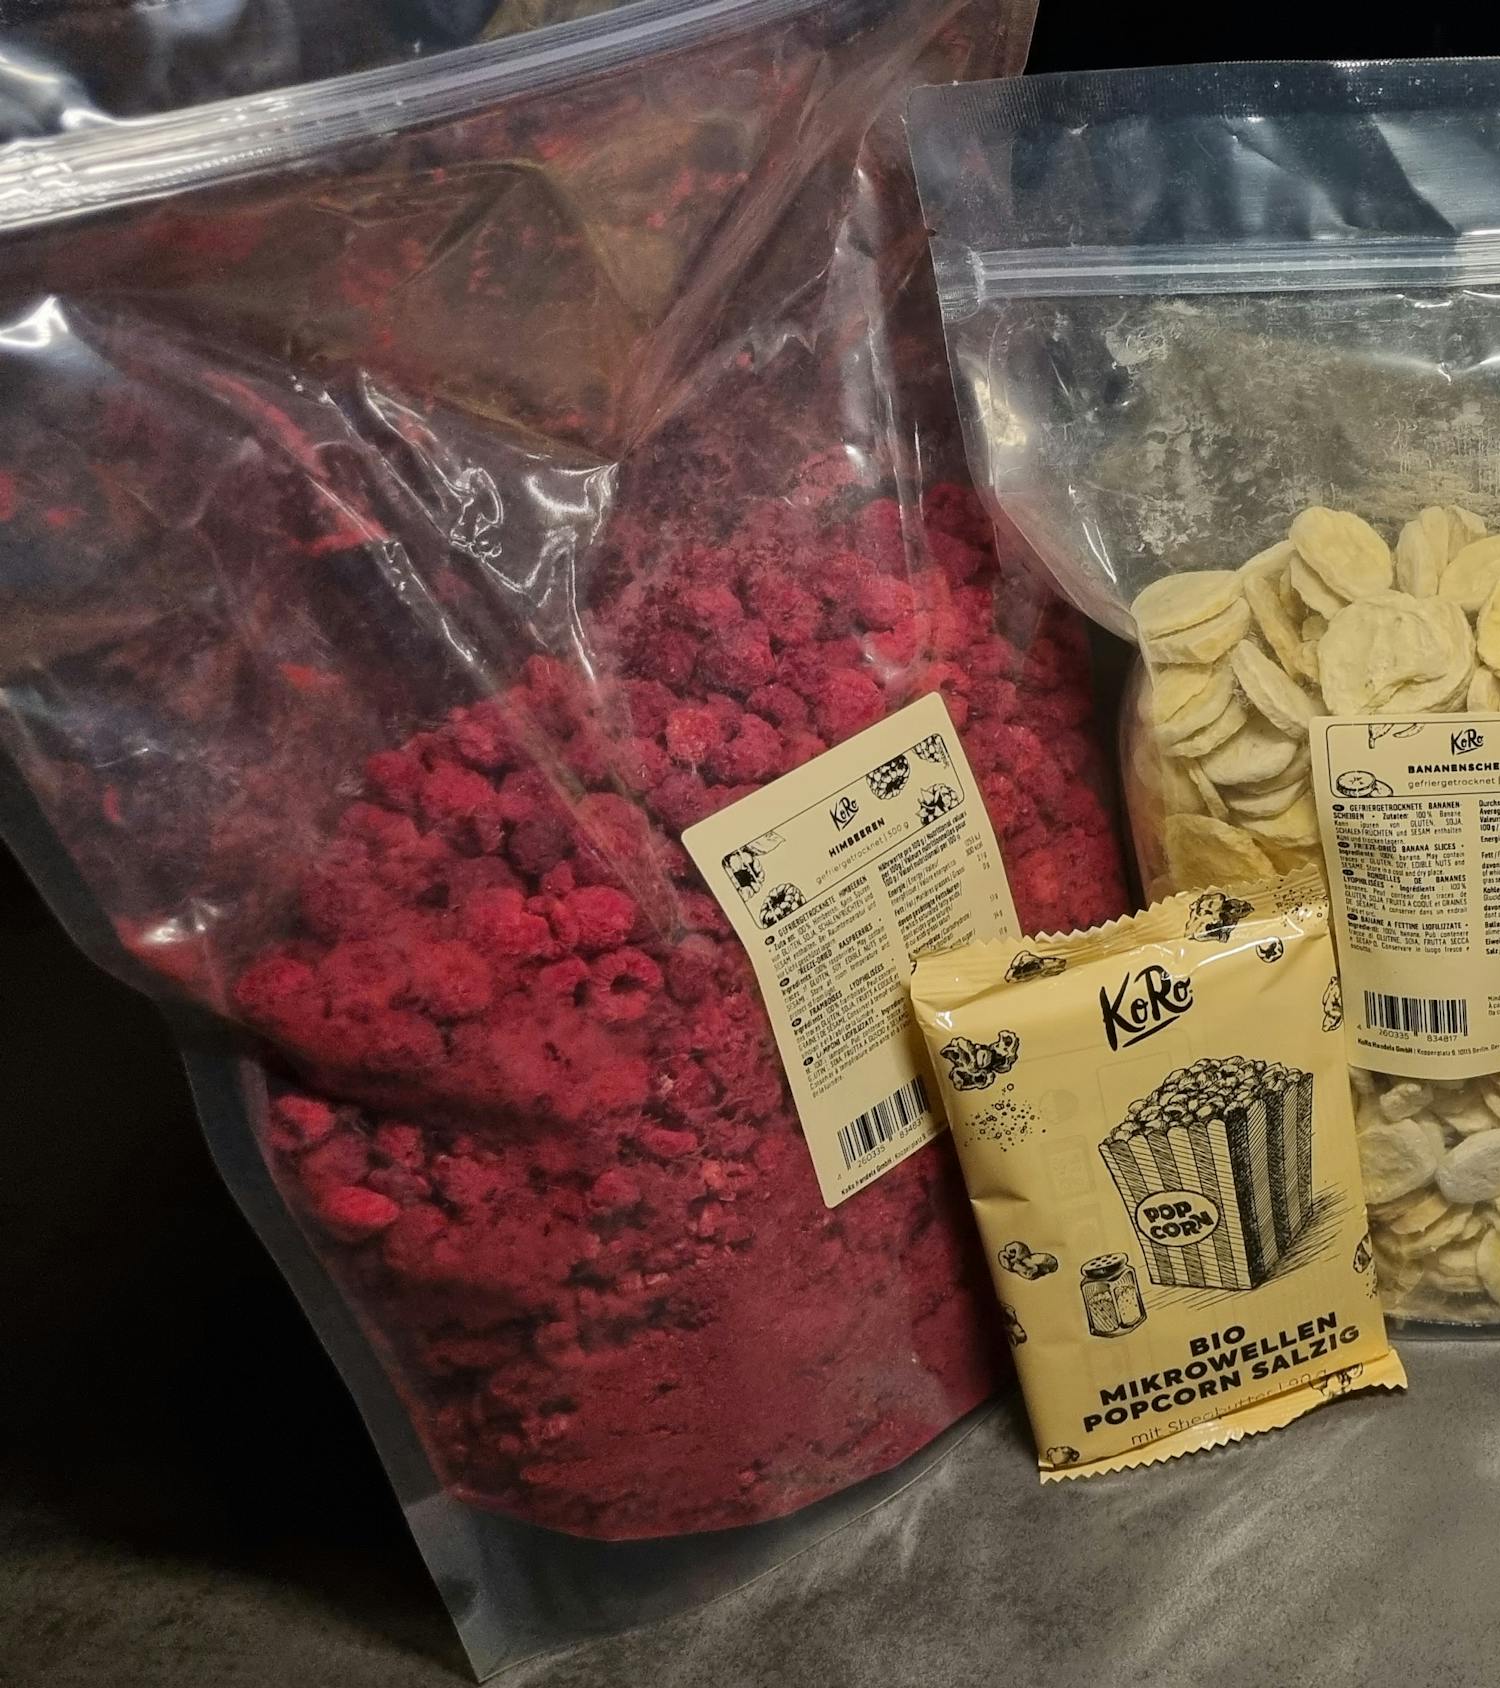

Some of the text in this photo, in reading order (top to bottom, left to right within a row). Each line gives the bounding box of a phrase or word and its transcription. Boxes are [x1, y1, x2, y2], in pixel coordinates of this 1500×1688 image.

[1451, 729, 1484, 755] KoRo
[1408, 776, 1495, 789] gefriergetrocknet
[829, 797, 859, 832] KoRo
[1350, 803, 1422, 811] GEFRIERGETROCKNETE
[829, 817, 886, 857] HIMBEEREN
[888, 825, 901, 839] 500
[1481, 851, 1493, 859] Fett
[1436, 875, 1466, 883] BANANES
[810, 990, 842, 1016] FRAMBOISES
[1099, 964, 1193, 1051] KoRo
[1379, 1030, 1409, 1039] 260335
[1143, 1200, 1193, 1224] POP
[1149, 1209, 1214, 1239] CORN
[1189, 1325, 1245, 1357] BIO
[1100, 1311, 1337, 1407] MIKROWELLEN
[1083, 1325, 1360, 1433] POPCORN SALZIG
[1131, 1427, 1162, 1446] mit
